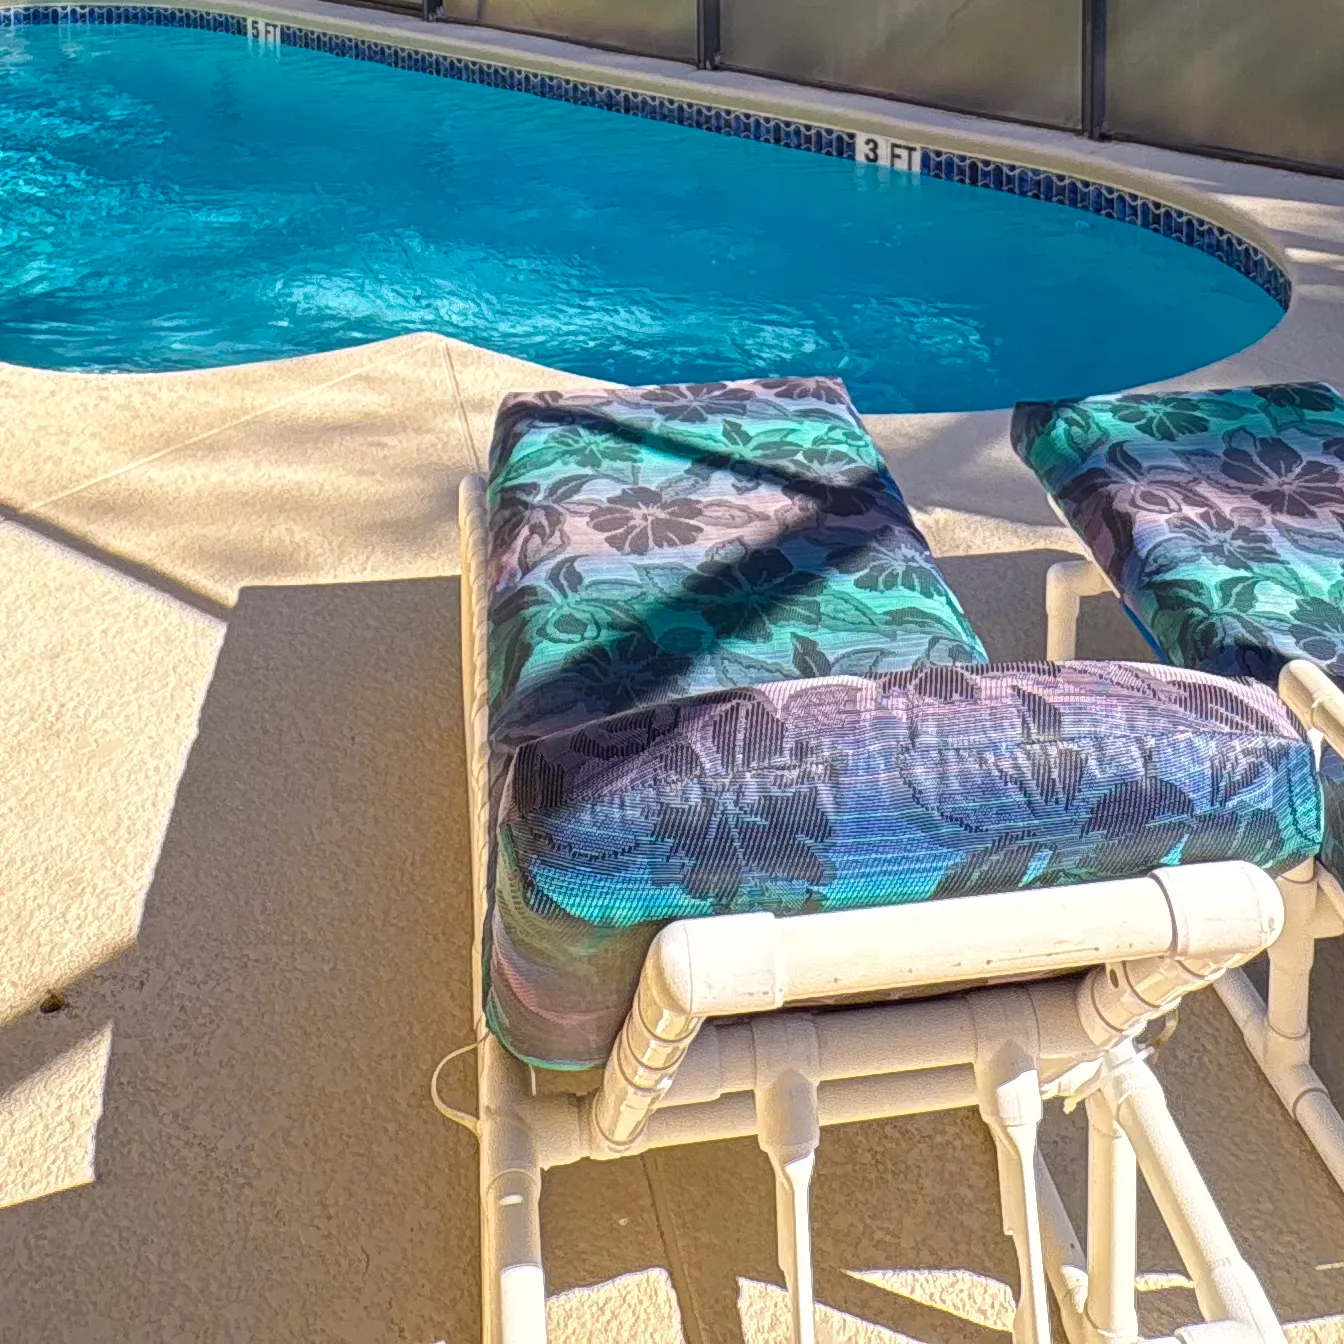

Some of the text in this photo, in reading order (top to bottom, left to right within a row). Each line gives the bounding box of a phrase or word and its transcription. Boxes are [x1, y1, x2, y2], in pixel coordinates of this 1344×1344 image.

[251, 20, 278, 45] 5 FT
[864, 138, 917, 171] 3 FT
